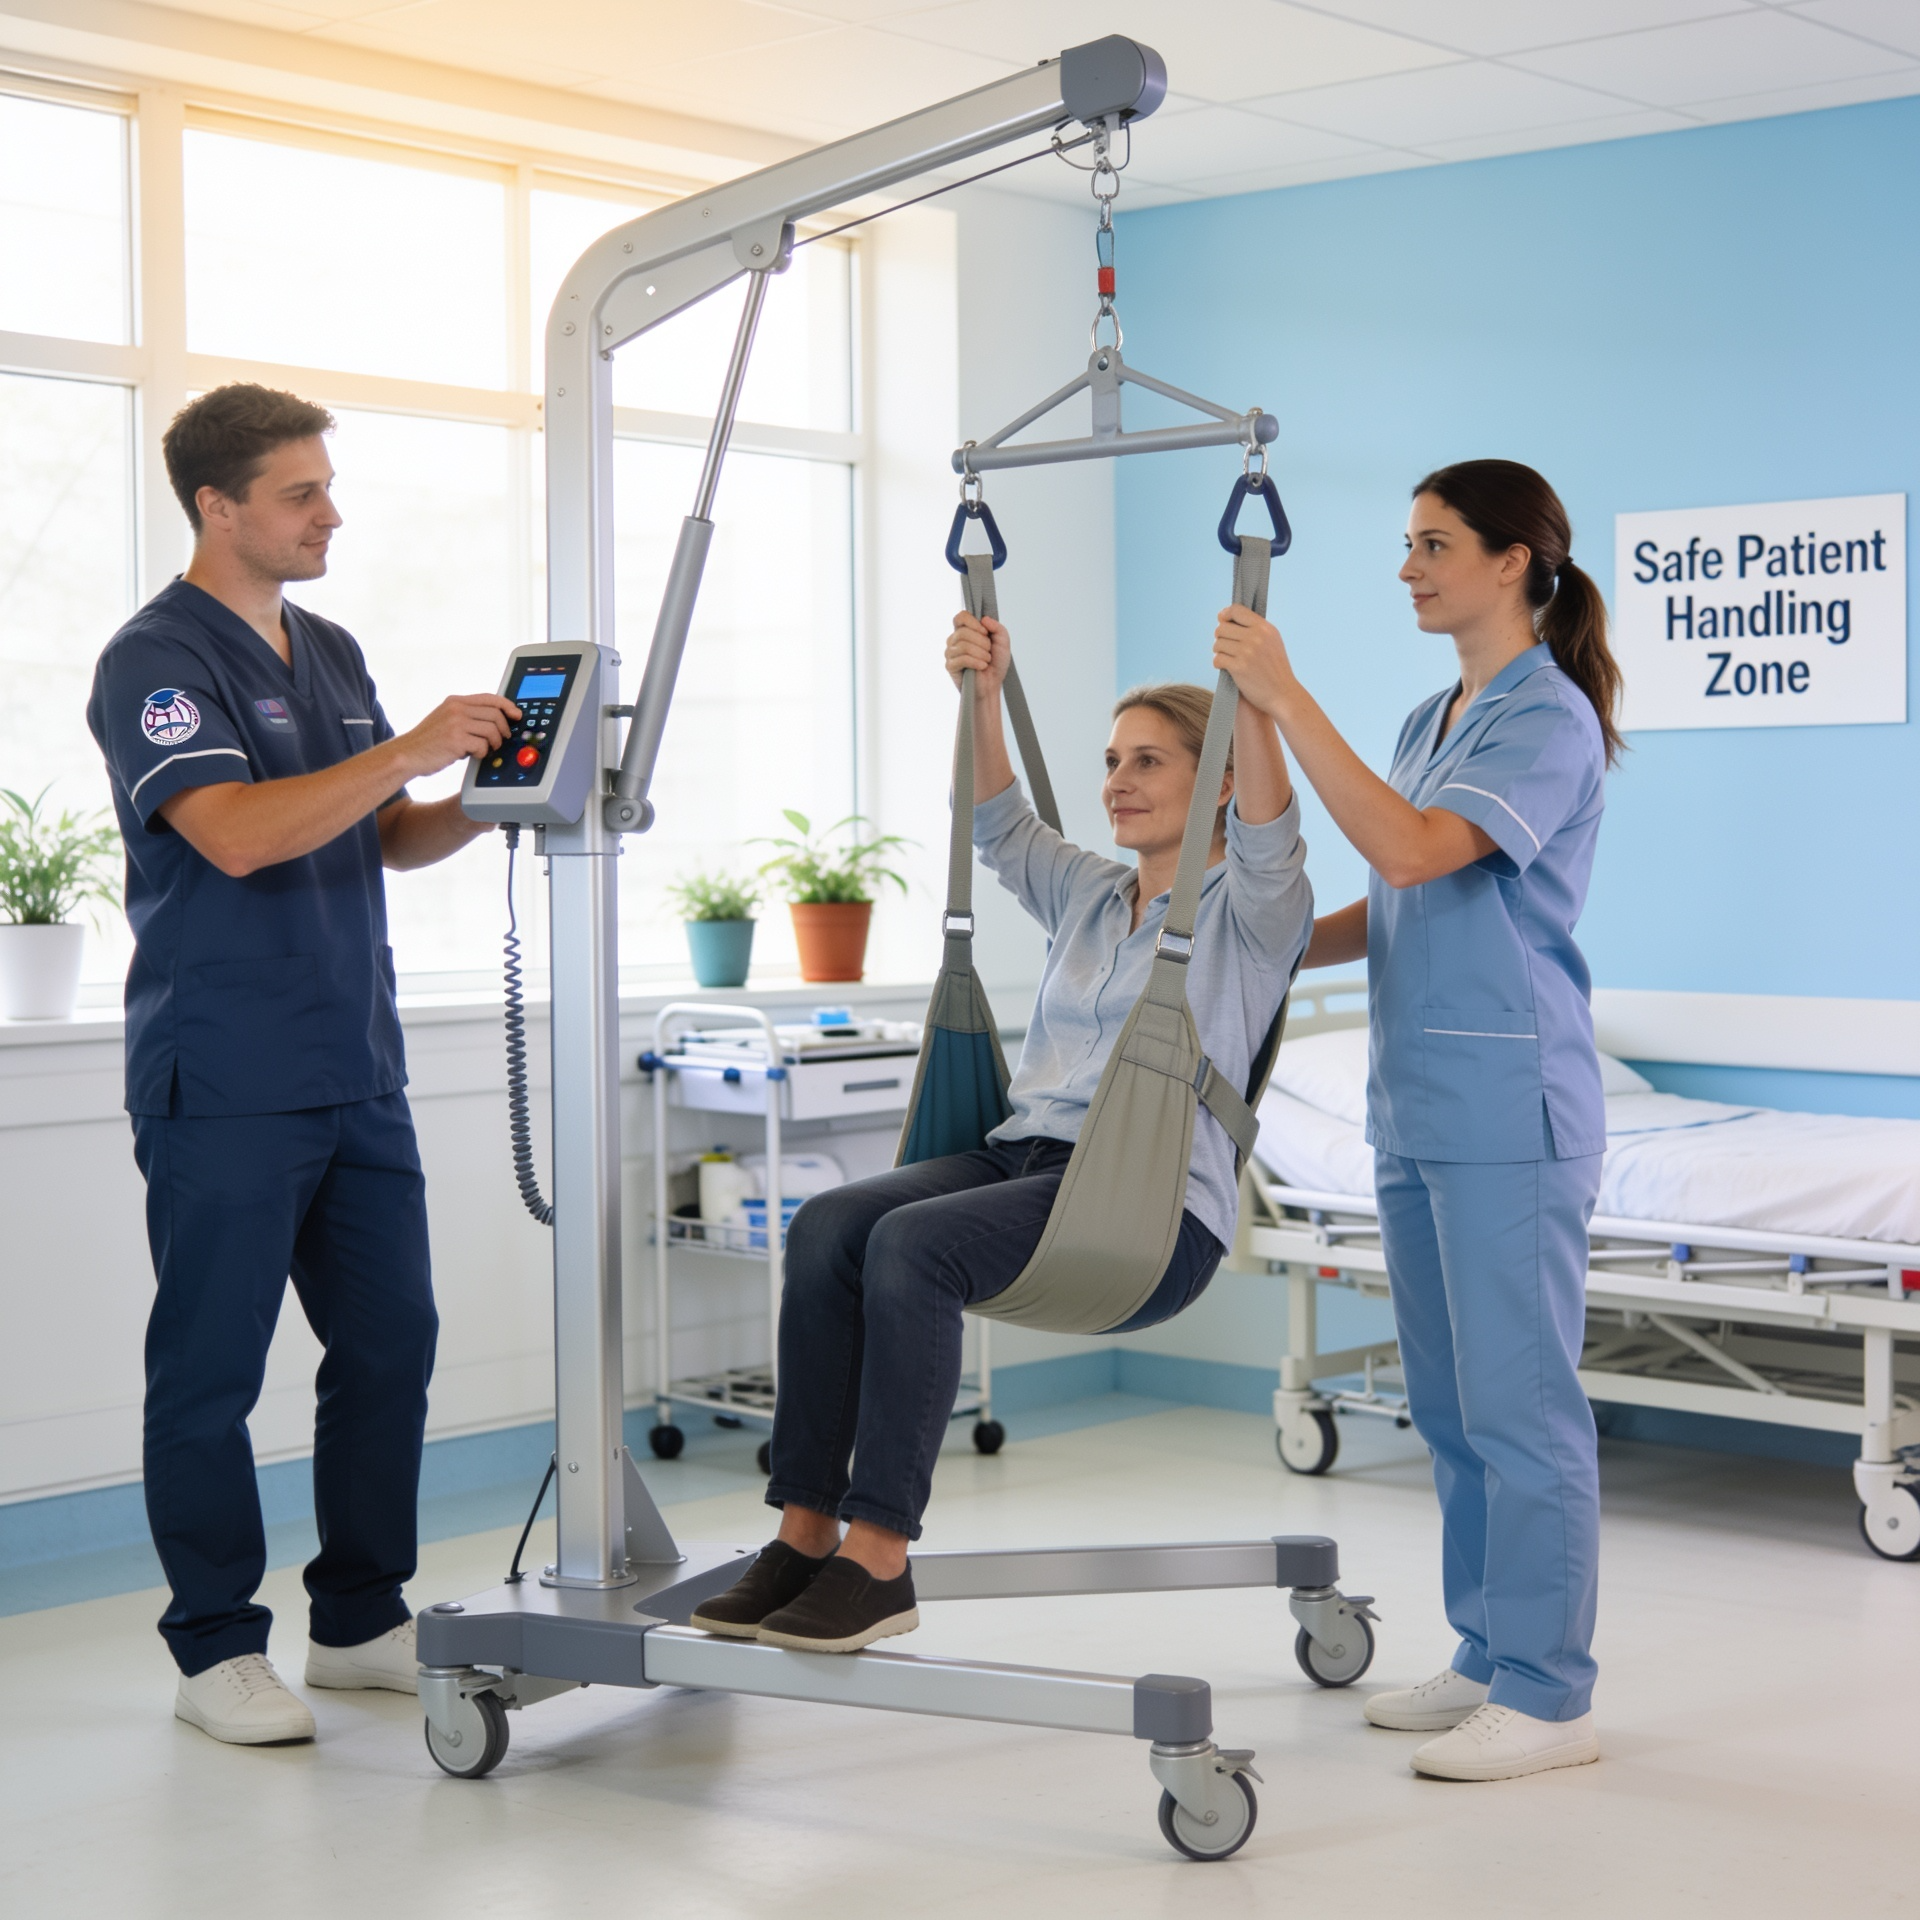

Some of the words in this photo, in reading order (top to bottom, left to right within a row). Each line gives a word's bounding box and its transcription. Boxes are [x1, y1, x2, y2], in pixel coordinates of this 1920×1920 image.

[1633, 536, 1723, 584] Safe
[1738, 529, 1887, 579] Patient
[1666, 589, 1851, 645] Handling
[1705, 652, 1810, 697] Zone
